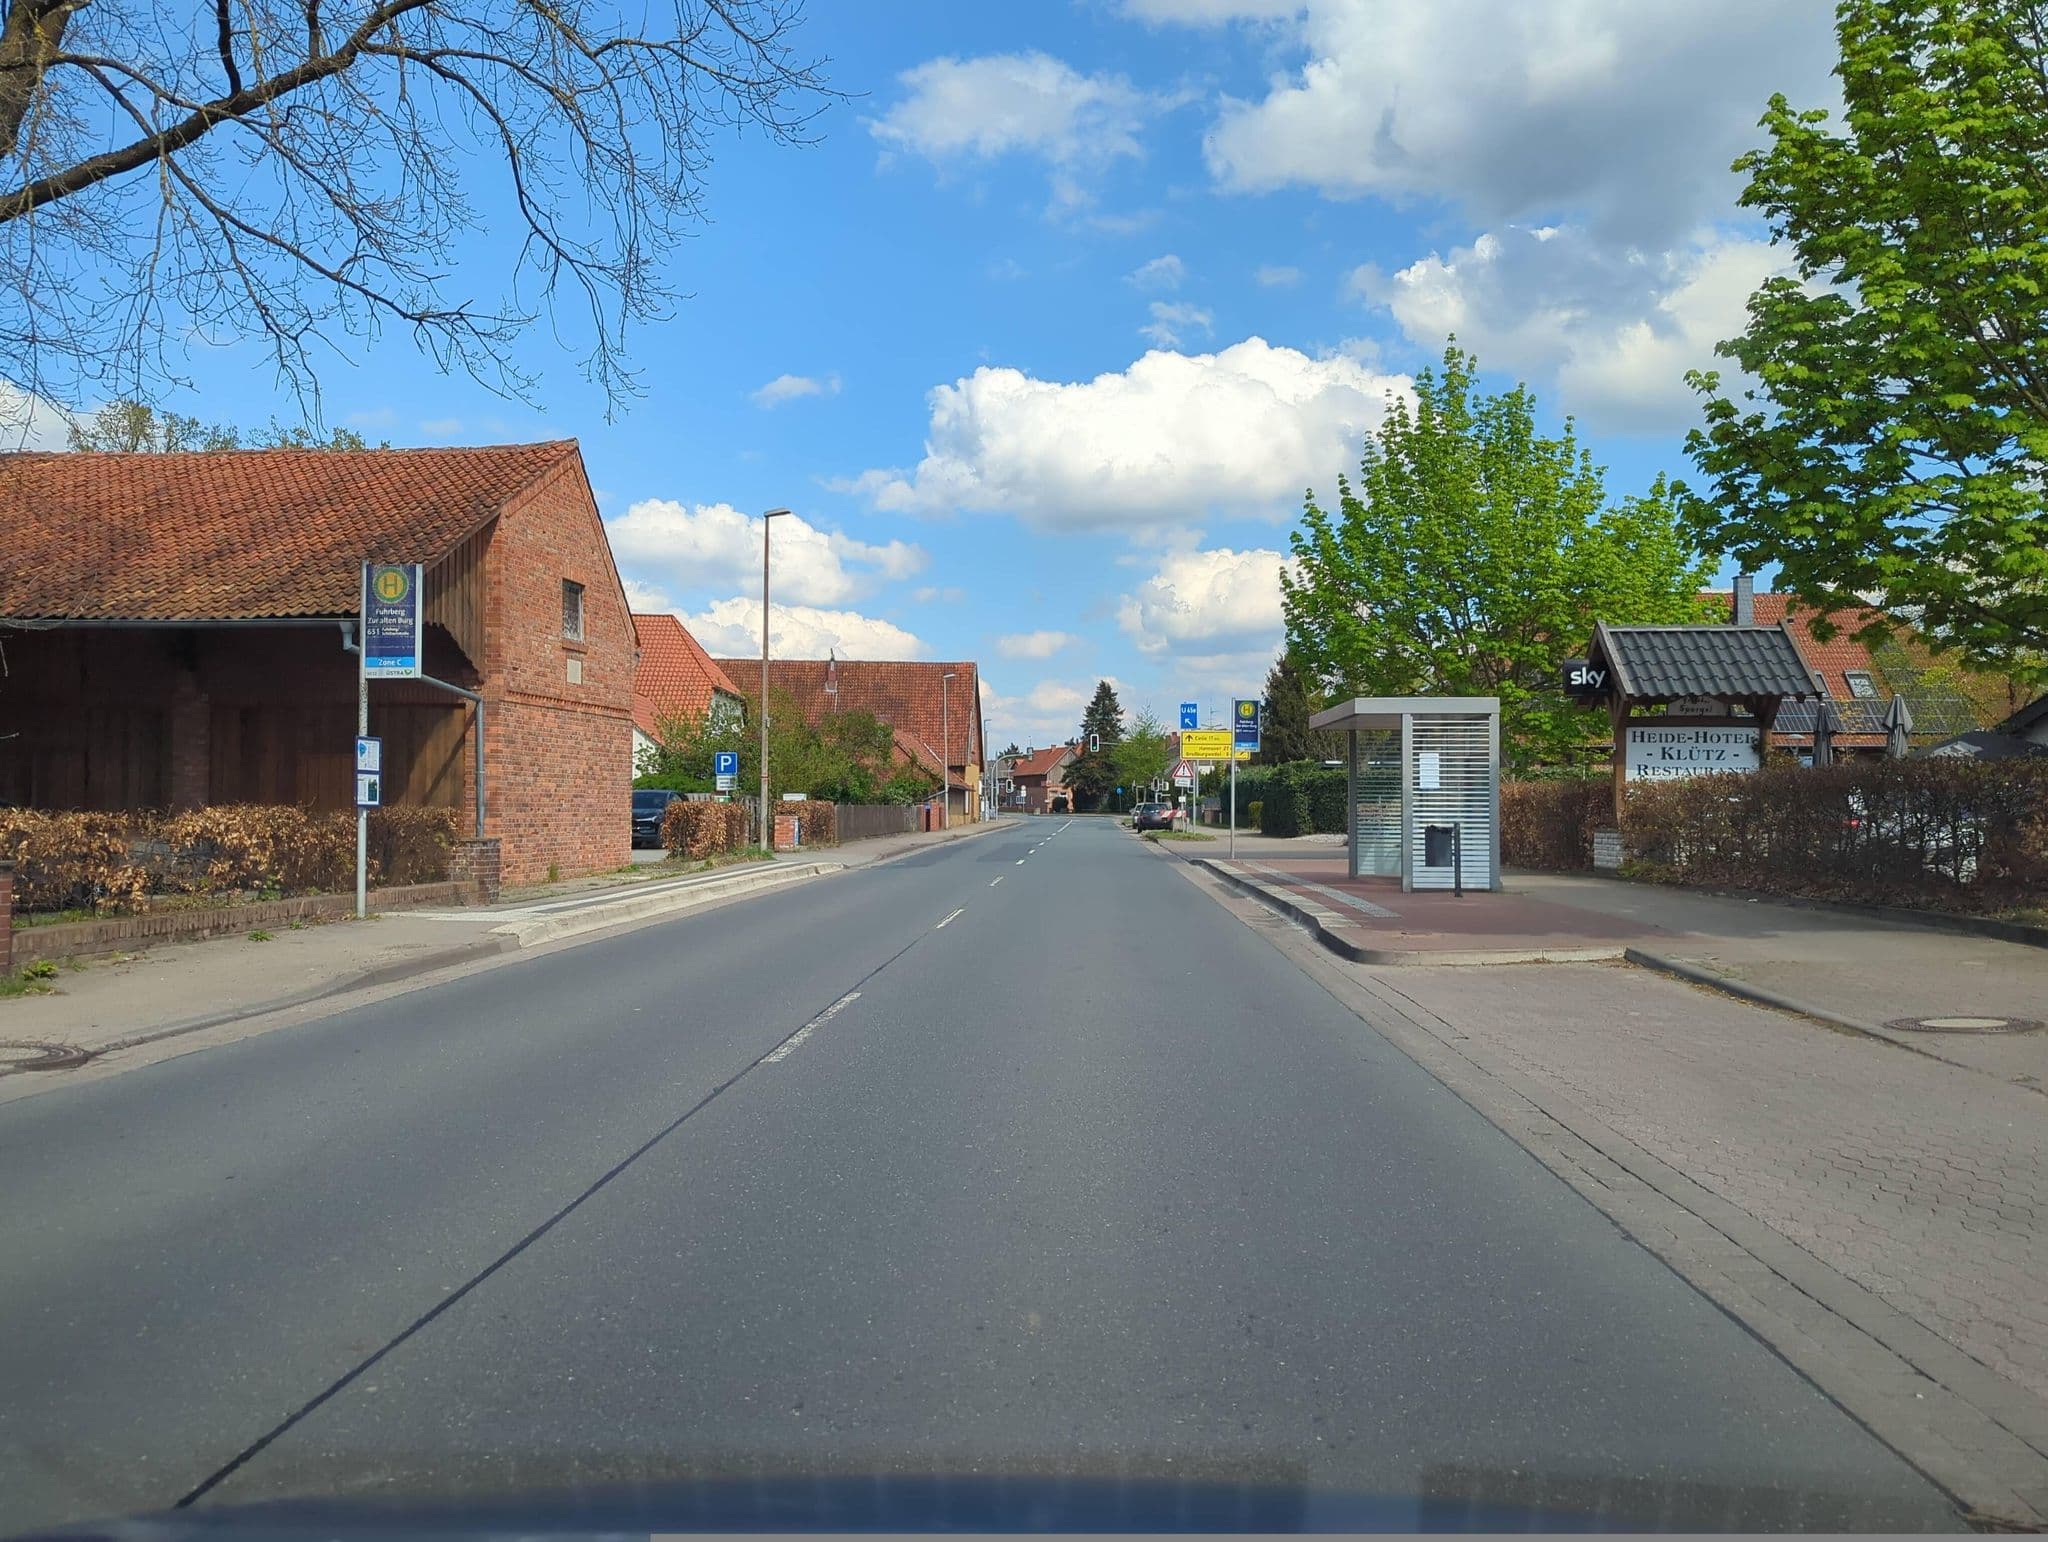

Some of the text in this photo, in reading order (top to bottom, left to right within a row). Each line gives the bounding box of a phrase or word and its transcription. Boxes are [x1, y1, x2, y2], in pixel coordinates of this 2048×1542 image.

[383, 575, 398, 594] H
[375, 608, 406, 617] Fuhrberg
[367, 617, 414, 626] Zur alten Burg
[377, 658, 402, 666] Zone C
[1570, 666, 1606, 689] sky
[1243, 704, 1251, 715] H
[1660, 746, 1727, 761] KLÜTZ
[720, 755, 732, 772] P
